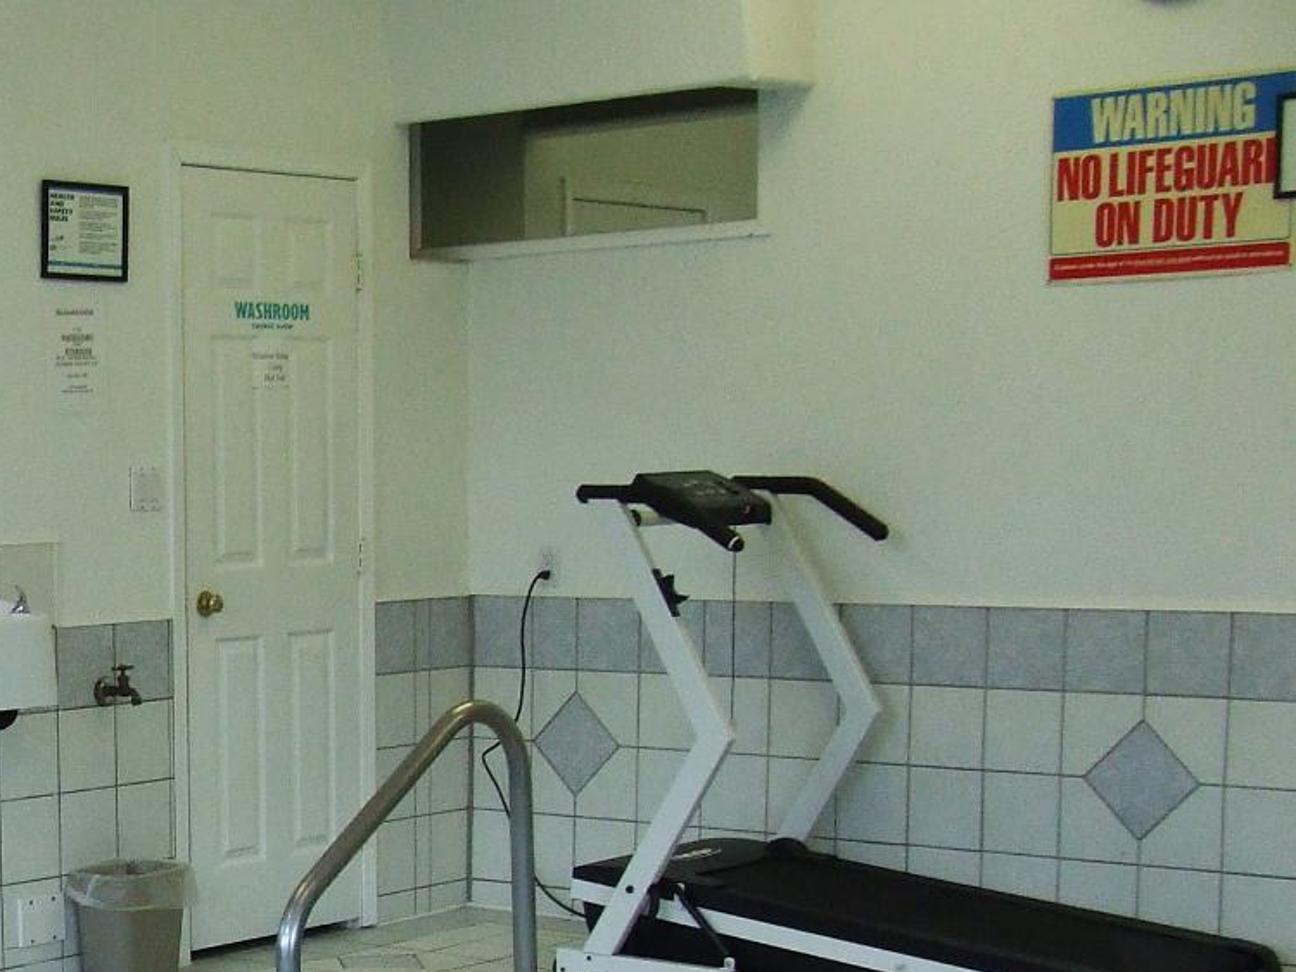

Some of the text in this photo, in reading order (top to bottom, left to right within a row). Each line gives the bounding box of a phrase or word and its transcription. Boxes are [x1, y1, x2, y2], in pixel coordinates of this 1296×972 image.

[1091, 81, 1257, 144] WARNING
[1057, 154, 1102, 202] NO
[1095, 192, 1244, 248] ON DUTY
[234, 301, 310, 321] WASHROOM
